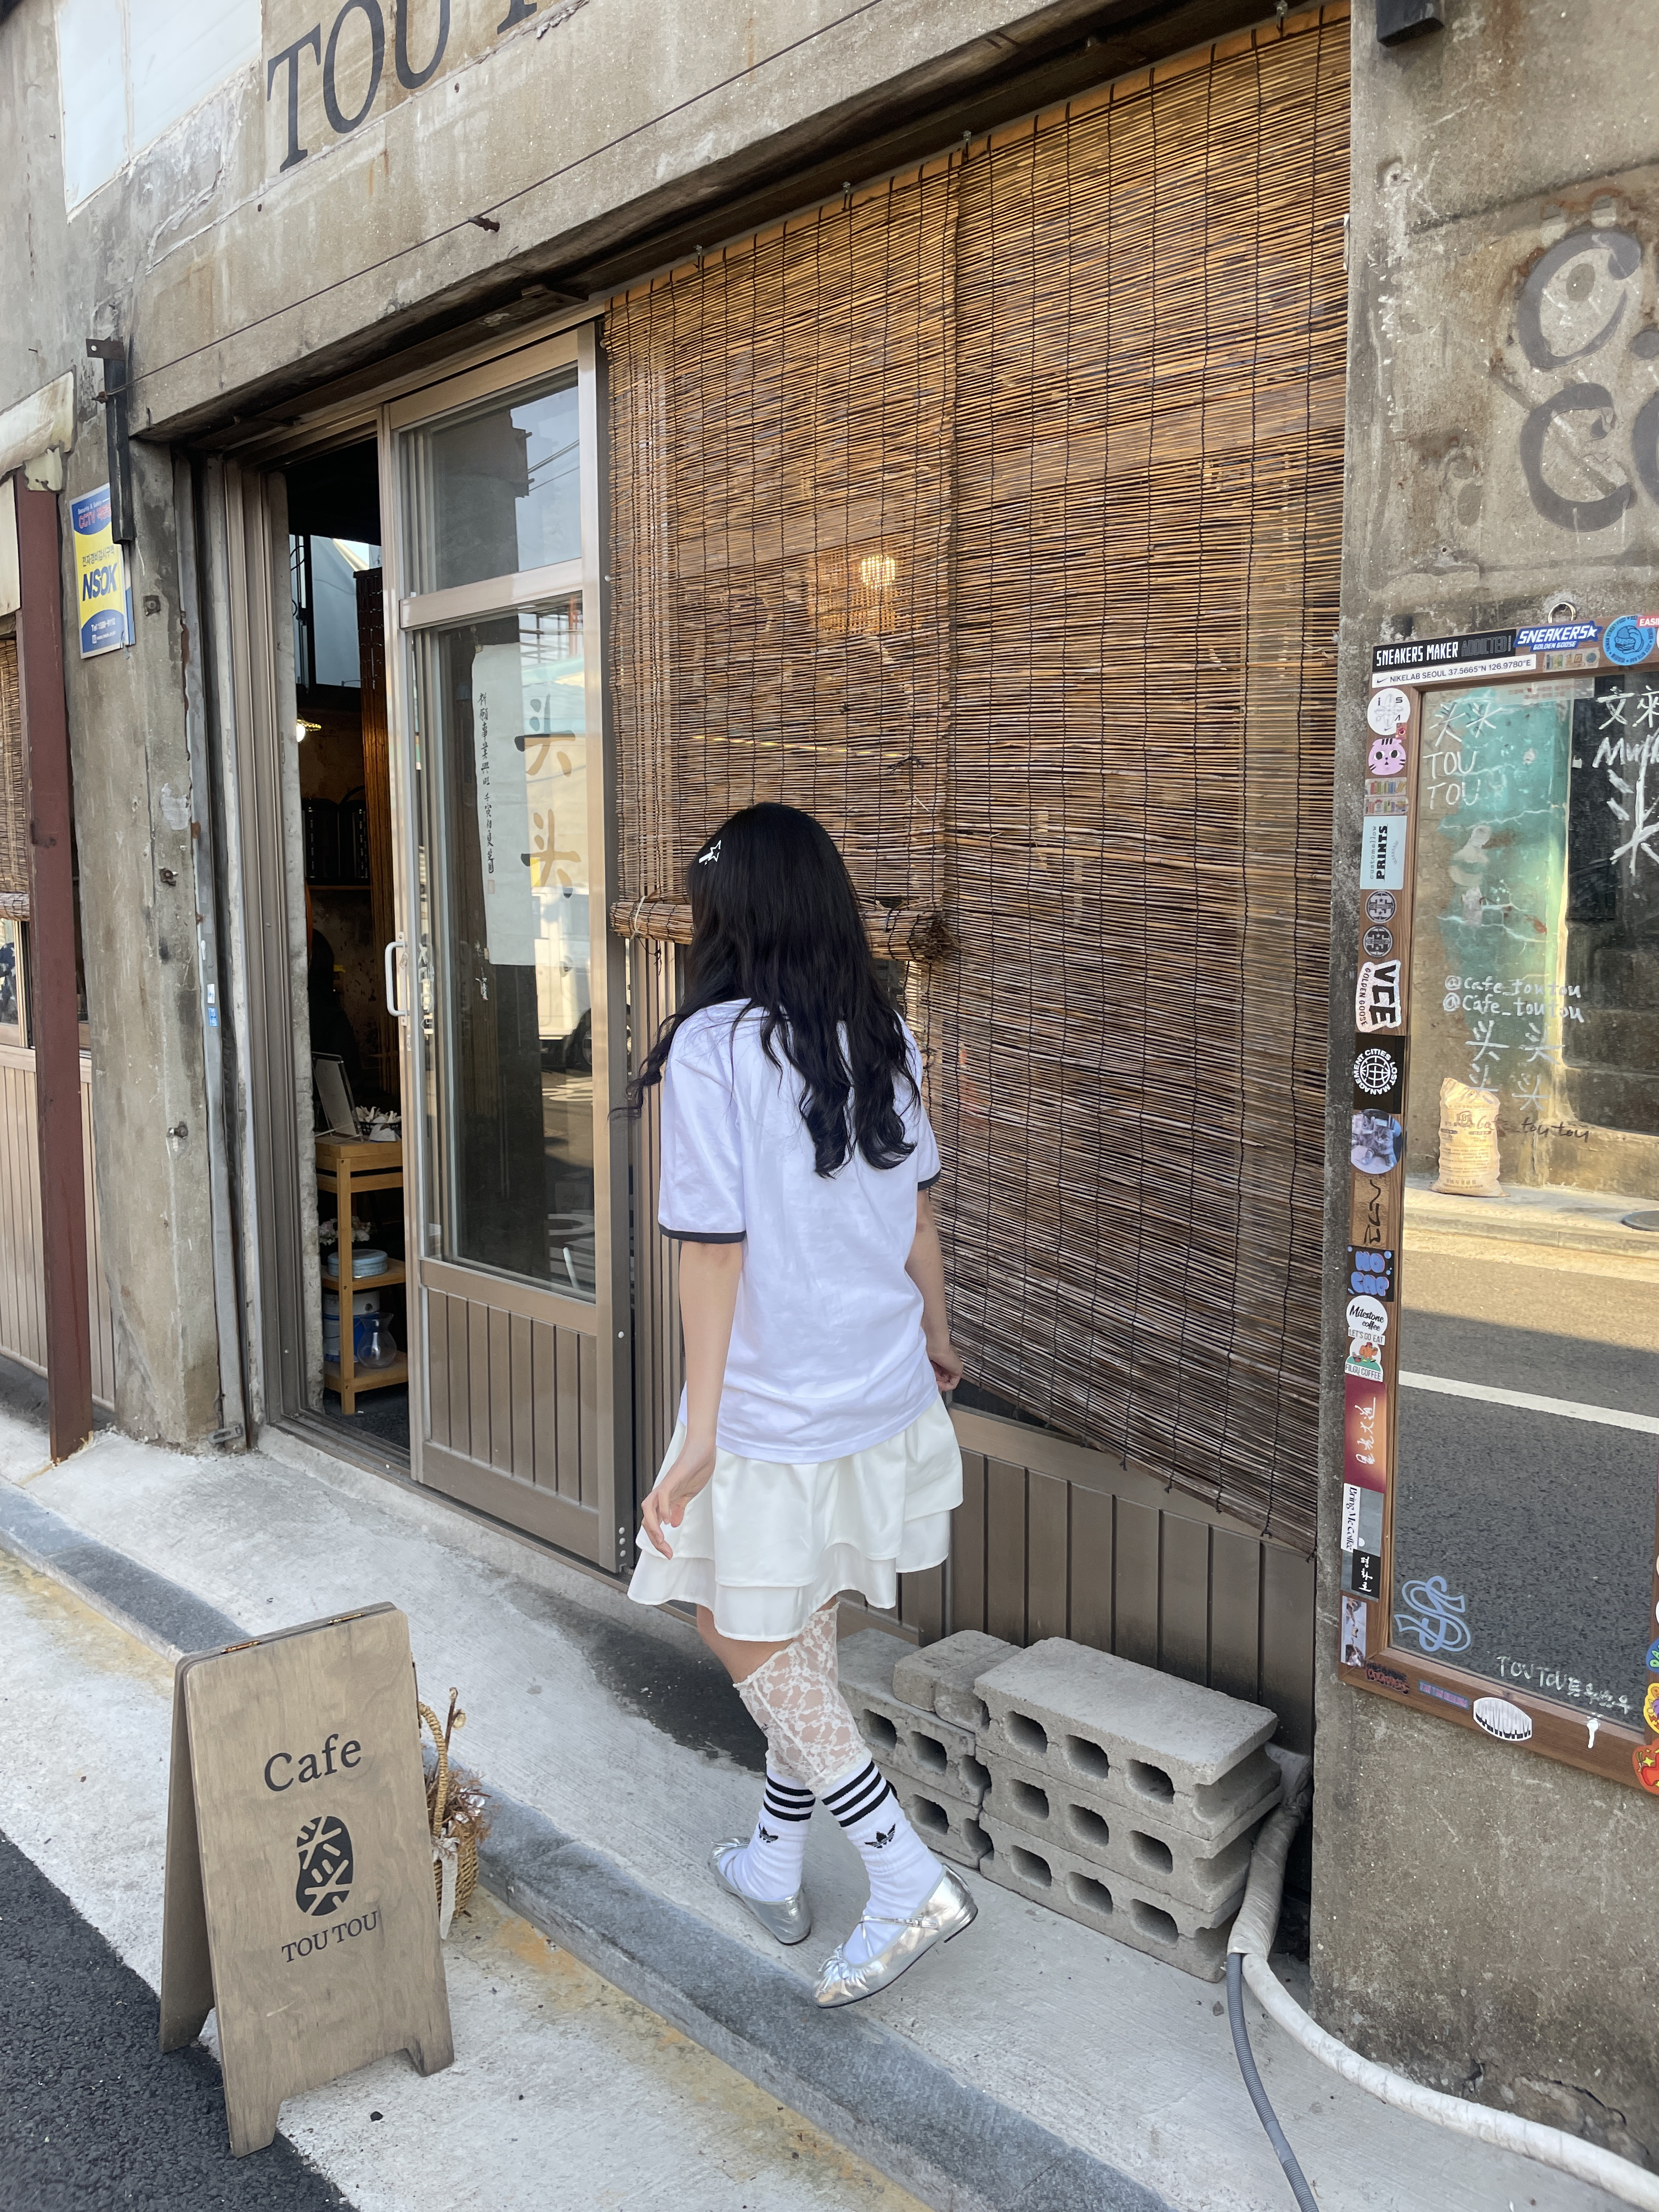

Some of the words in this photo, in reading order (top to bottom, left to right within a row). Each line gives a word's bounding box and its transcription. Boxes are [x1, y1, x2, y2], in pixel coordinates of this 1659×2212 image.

[78, 510, 95, 529] CCTV
[83, 563, 117, 601] NSOK
[1517, 625, 1588, 645] SNEAKERS
[1533, 642, 1556, 650] GOLDEN
[1376, 646, 1424, 667] SNEAKERS
[1426, 641, 1459, 661] MAKER
[1390, 673, 1420, 682] NIKELAB
[1422, 670, 1447, 679] SEOUL
[1423, 751, 1480, 780] TOU
[1427, 779, 1481, 809] TOU
[1376, 825, 1387, 880] PRINTS
[1359, 967, 1371, 997] GOLDEN
[1358, 1000, 1368, 1026] GOOSE
[1364, 1048, 1392, 1060] CITIES
[1353, 1053, 1391, 1096] MANAGEMENT
[1389, 1061, 1397, 1086] LOST
[1350, 1305, 1384, 1323] Milestone
[1362, 1320, 1380, 1331] coffee
[1349, 1328, 1363, 1339] LET'S
[1364, 1333, 1372, 1341] GO
[1373, 1335, 1384, 1344] EAT
[1361, 1368, 1381, 1380] COFFEE
[1346, 1487, 1357, 1510] Bring
[1347, 1511, 1356, 1526] Me
[1346, 1526, 1355, 1551] Coffee
[264, 1734, 362, 1792] Cafe
